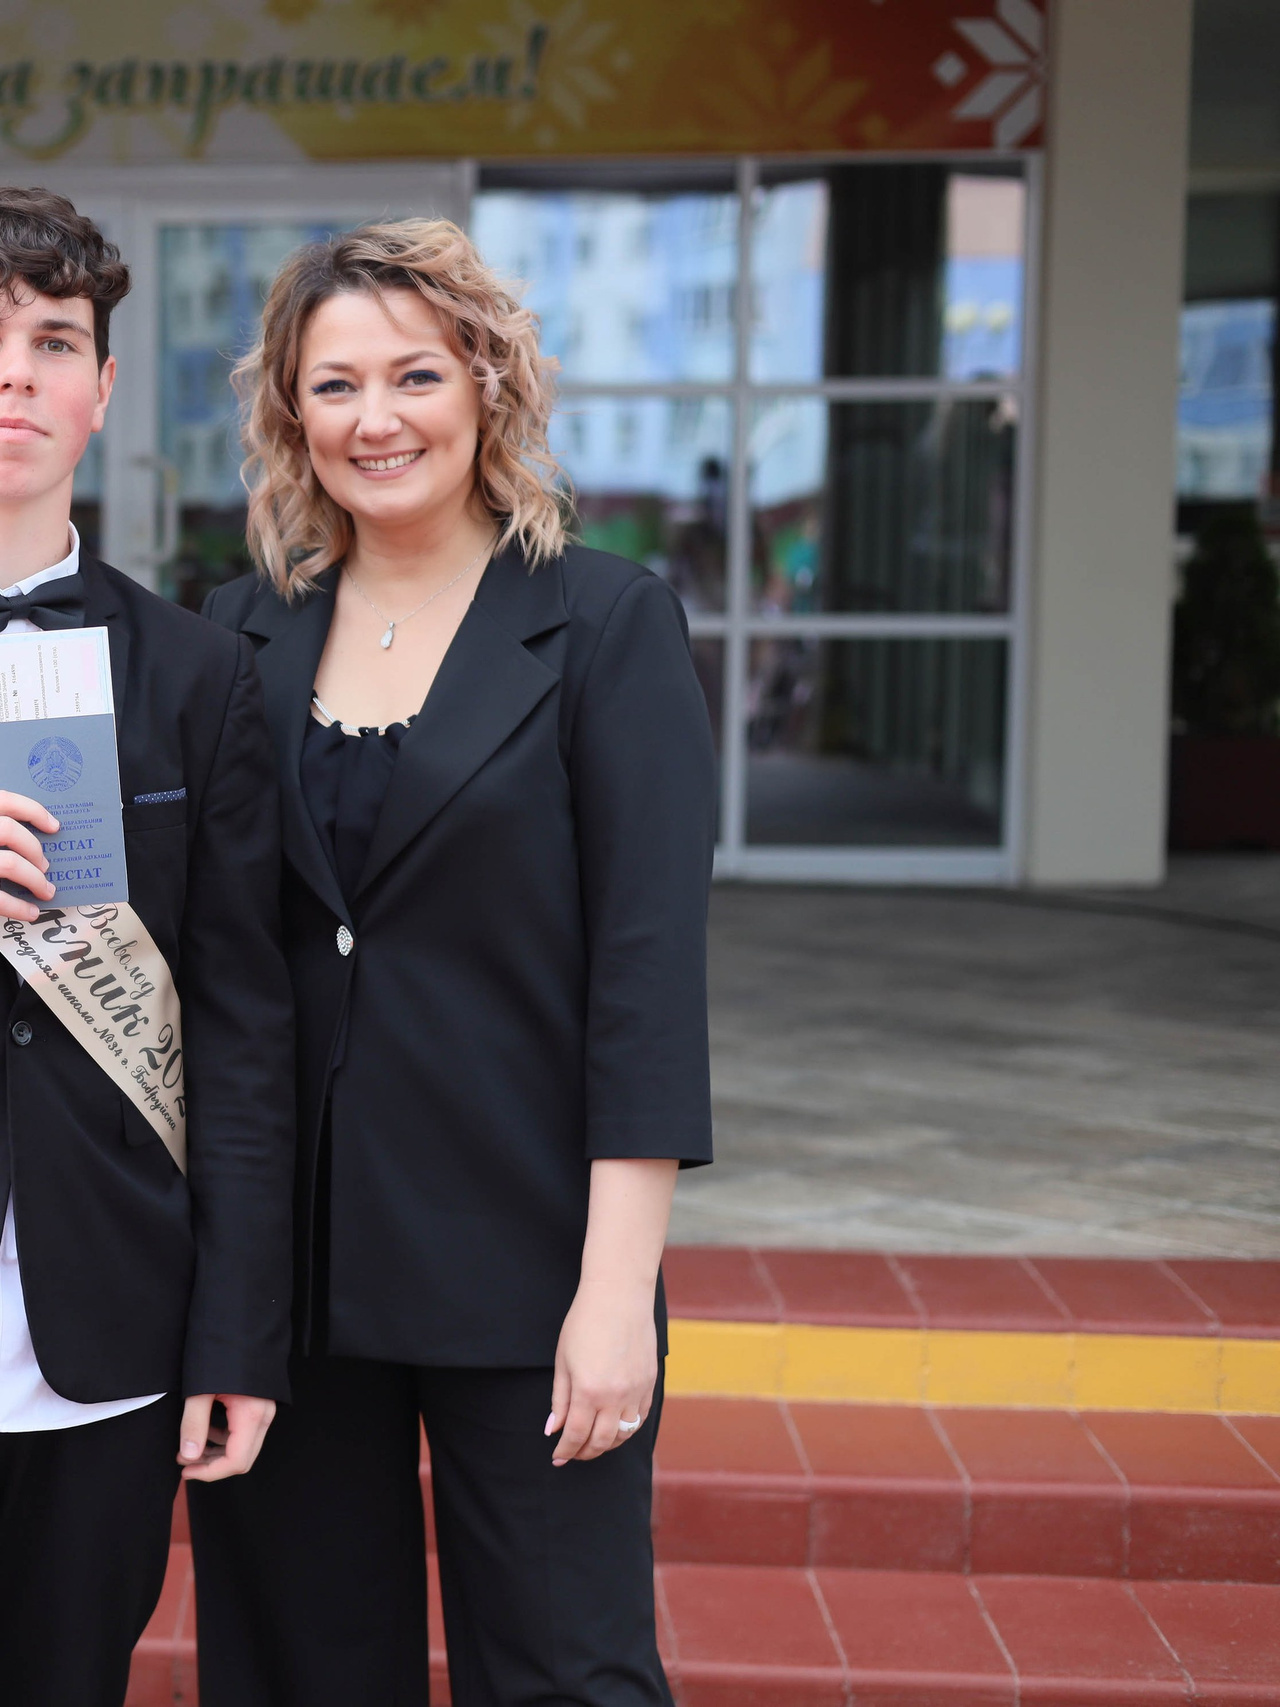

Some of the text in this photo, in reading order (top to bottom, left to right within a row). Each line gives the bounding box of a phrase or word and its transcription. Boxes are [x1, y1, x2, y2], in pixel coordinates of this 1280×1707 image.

[0, 23, 548, 159] запрашаем!
[41, 838, 95, 853] ТЭСТАТ
[46, 868, 102, 882] ТЕСТАТ
[77, 902, 156, 1001] Всеволод
[2, 918, 59, 982] Средняя
[58, 984, 95, 1025] школа
[93, 1027, 123, 1057] №34
[130, 1064, 176, 1131] Бобруйска
